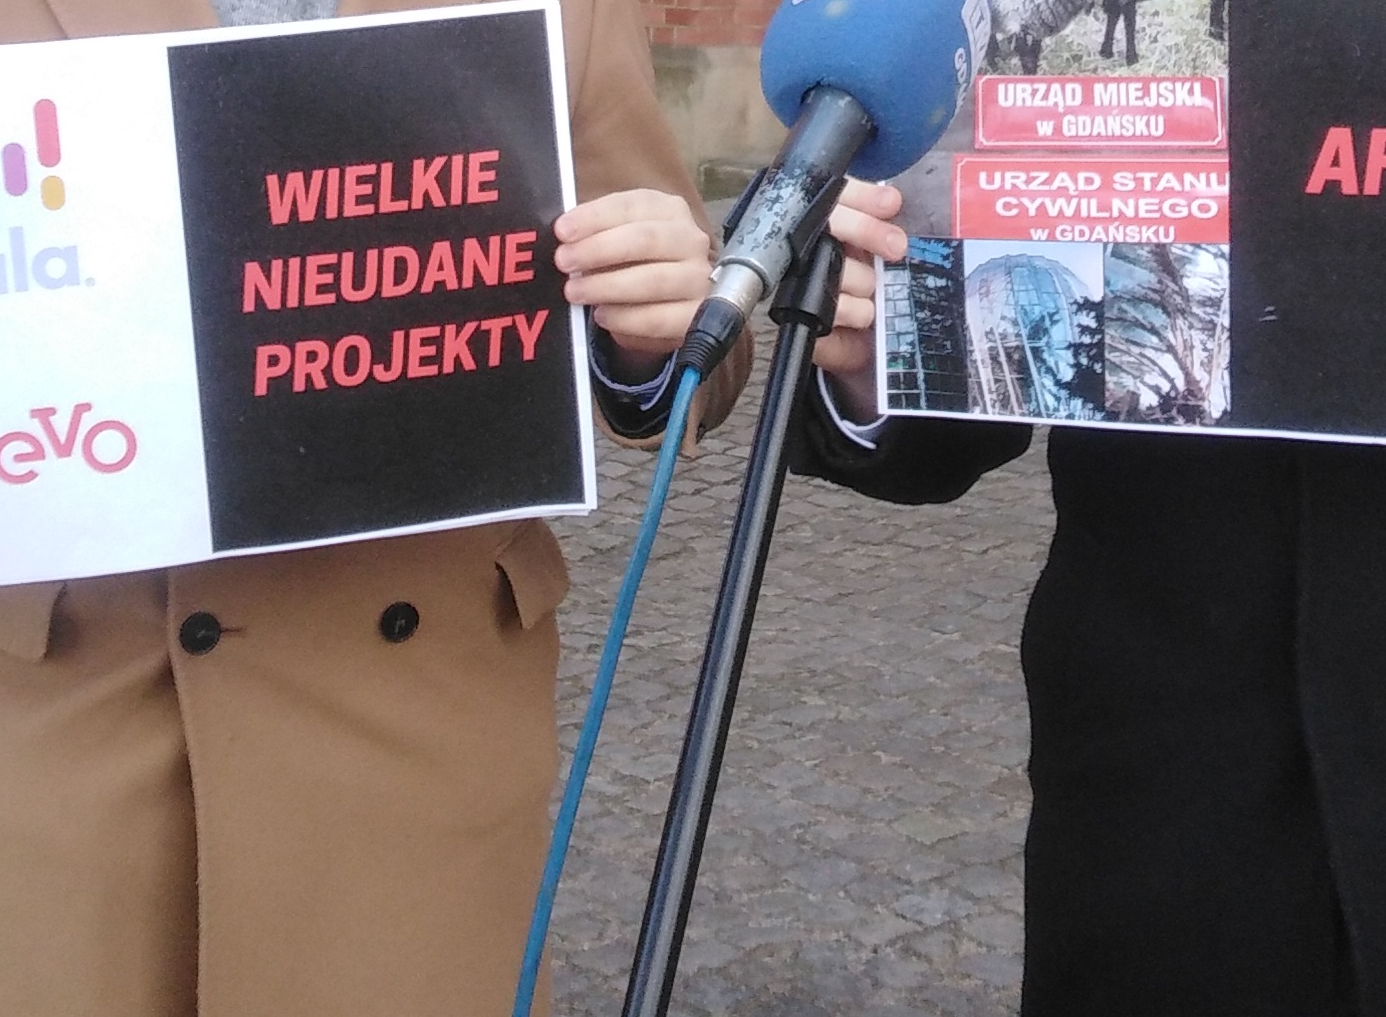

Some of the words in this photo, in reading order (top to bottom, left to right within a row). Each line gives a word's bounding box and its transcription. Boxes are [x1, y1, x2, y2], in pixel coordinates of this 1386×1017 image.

[997, 82, 1083, 112] URZĄD
[1093, 82, 1203, 108] MIEJSKI
[1036, 120, 1054, 136] w
[1062, 109, 1164, 137] GDAŃSKU
[265, 149, 501, 226] WIELKIE
[979, 171, 1101, 195] URZĄD
[995, 197, 1219, 219] CYWILNEGO
[1030, 228, 1050, 240] w
[1055, 222, 1176, 243] GDAŃSKU
[242, 230, 538, 314] NIEUDANE
[253, 309, 550, 397] PROJEKTY
